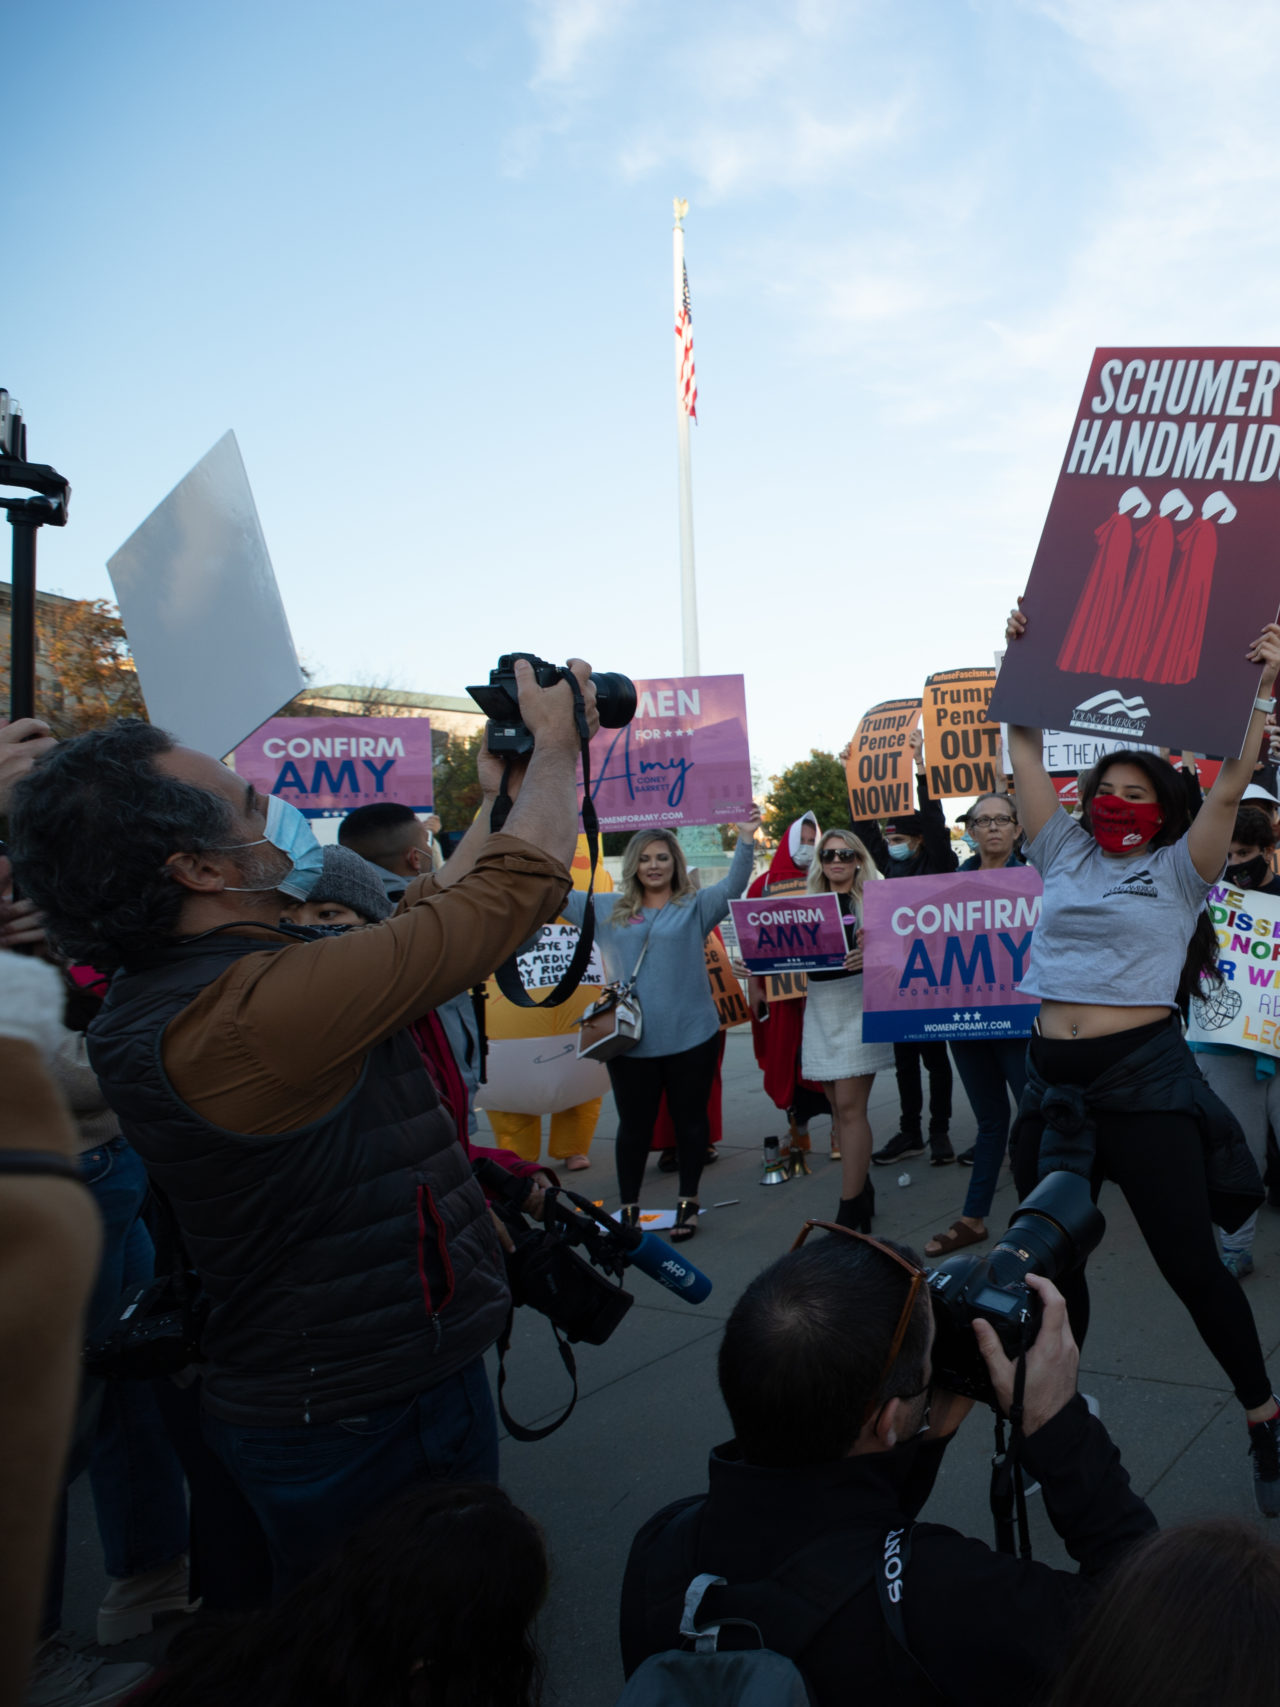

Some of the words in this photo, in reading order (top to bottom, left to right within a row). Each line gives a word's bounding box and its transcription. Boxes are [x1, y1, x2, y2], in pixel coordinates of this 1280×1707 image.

[862, 710, 916, 733] Trump/
[936, 708, 993, 727] Penc
[635, 728, 662, 741] FOR
[858, 733, 906, 752] Pence
[941, 728, 1000, 760] OUT
[262, 737, 406, 759] CONFIRM
[577, 722, 694, 808] Amy
[858, 751, 902, 783] OUT
[271, 760, 396, 794] AMY
[636, 775, 667, 785] CONEY
[635, 784, 670, 793] BARRETT
[852, 782, 909, 816] NOW!
[598, 811, 684, 825] OMENFORAMY.COM
[747, 908, 825, 926] CONFIRM
[891, 896, 1043, 936] CONFIRM
[757, 924, 821, 949] AMY
[898, 931, 1033, 989] AMY
[899, 986, 951, 997] CONEY
[965, 984, 1016, 993] BARRE
[924, 1021, 1012, 1032] WOMENFORAMY.COM
[661, 1260, 687, 1277] AFP
[884, 1528, 905, 1603] SONY
